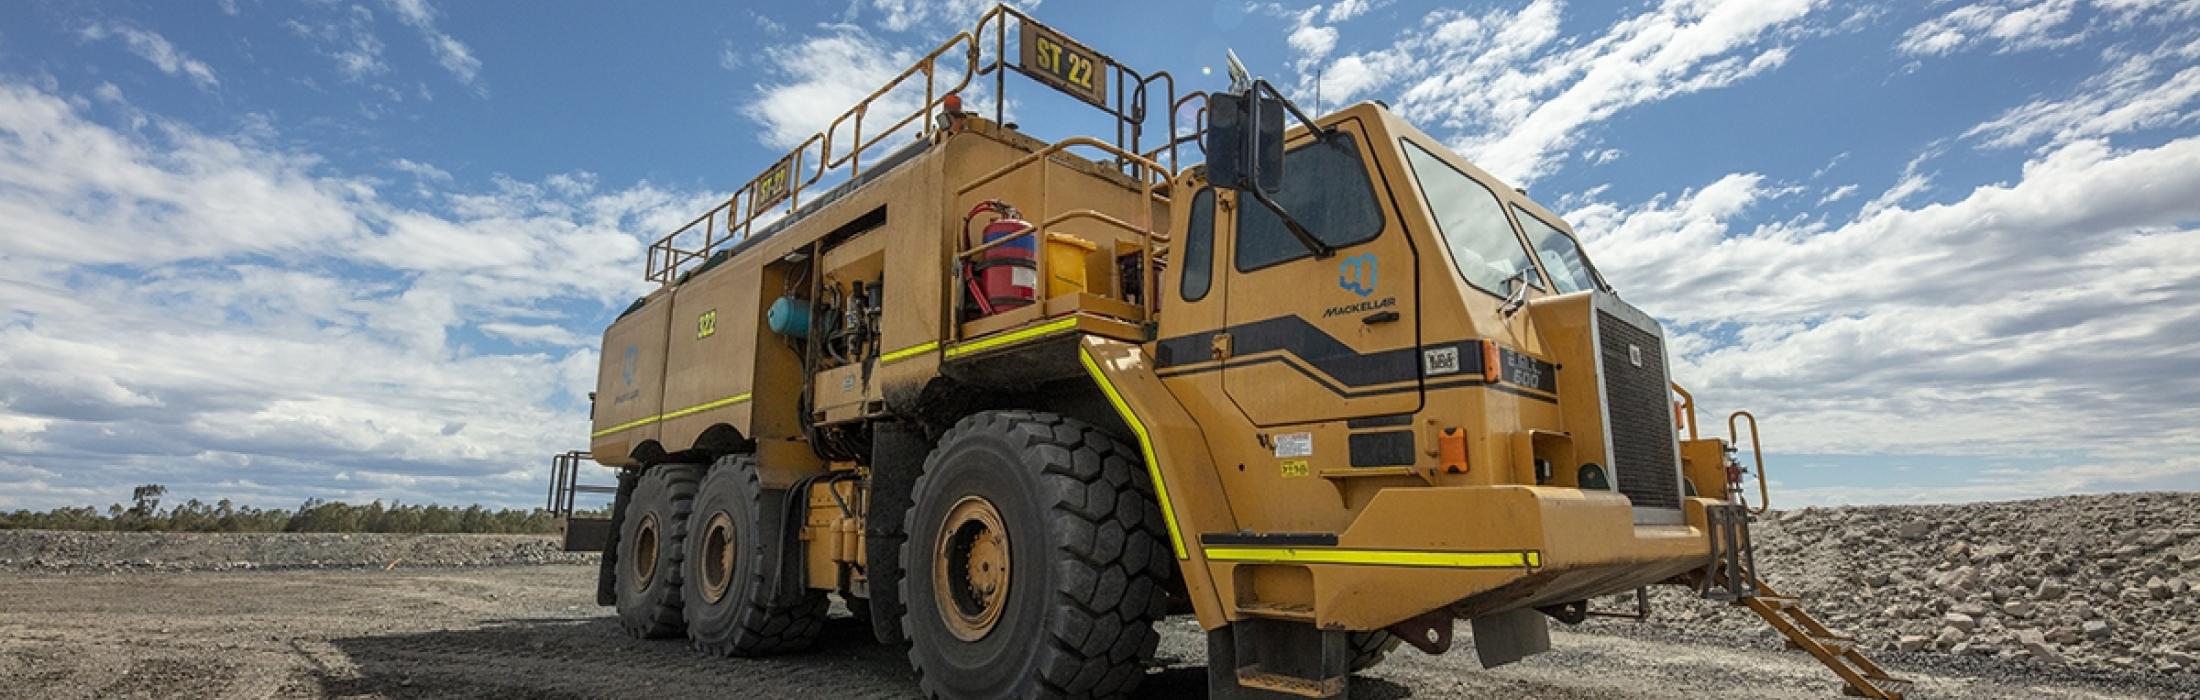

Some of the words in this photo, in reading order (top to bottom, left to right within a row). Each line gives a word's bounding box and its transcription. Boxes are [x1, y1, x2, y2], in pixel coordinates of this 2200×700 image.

[1036, 36, 1062, 75] ST
[1068, 52, 1092, 90] 22
[1323, 296, 1396, 319] MACKELLAR
